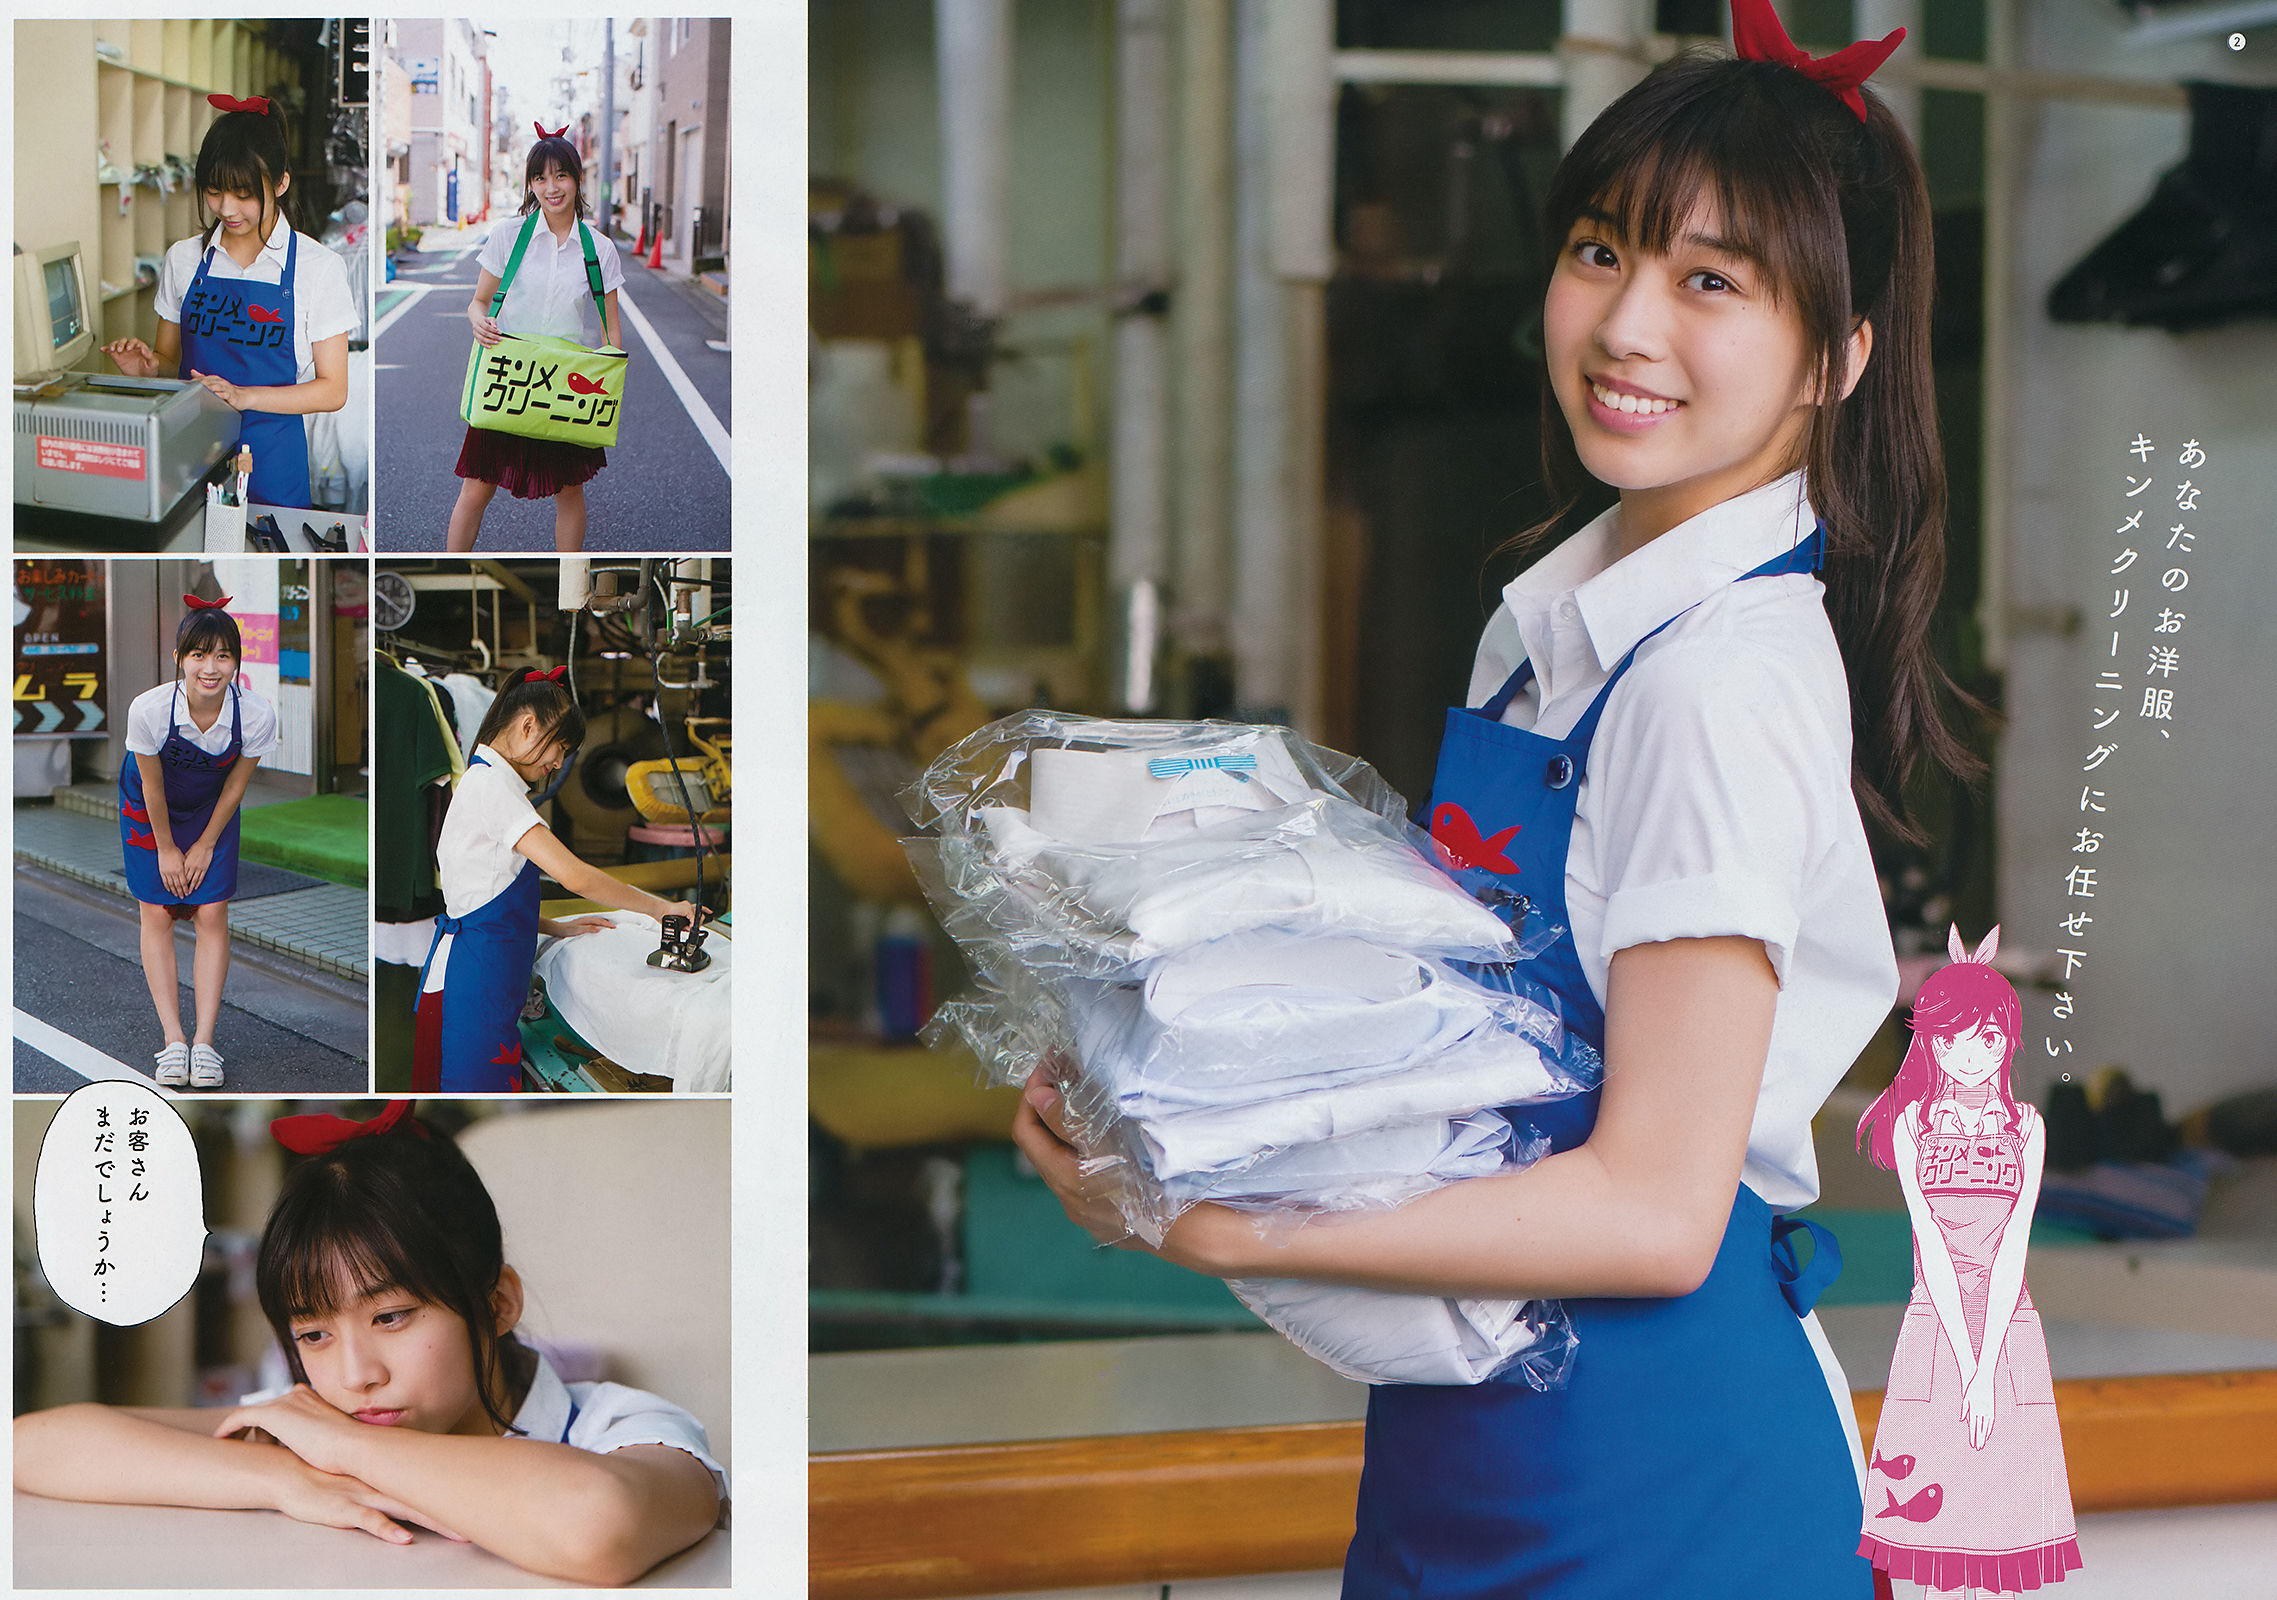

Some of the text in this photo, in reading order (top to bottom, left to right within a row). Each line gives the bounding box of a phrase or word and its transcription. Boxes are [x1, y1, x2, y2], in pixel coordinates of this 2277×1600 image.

[190, 291, 242, 319] キンメ
[486, 355, 559, 392] キンメ
[483, 382, 619, 427] クリーニング
[24, 632, 60, 643] OPEN
[167, 745, 212, 768] キンメ
